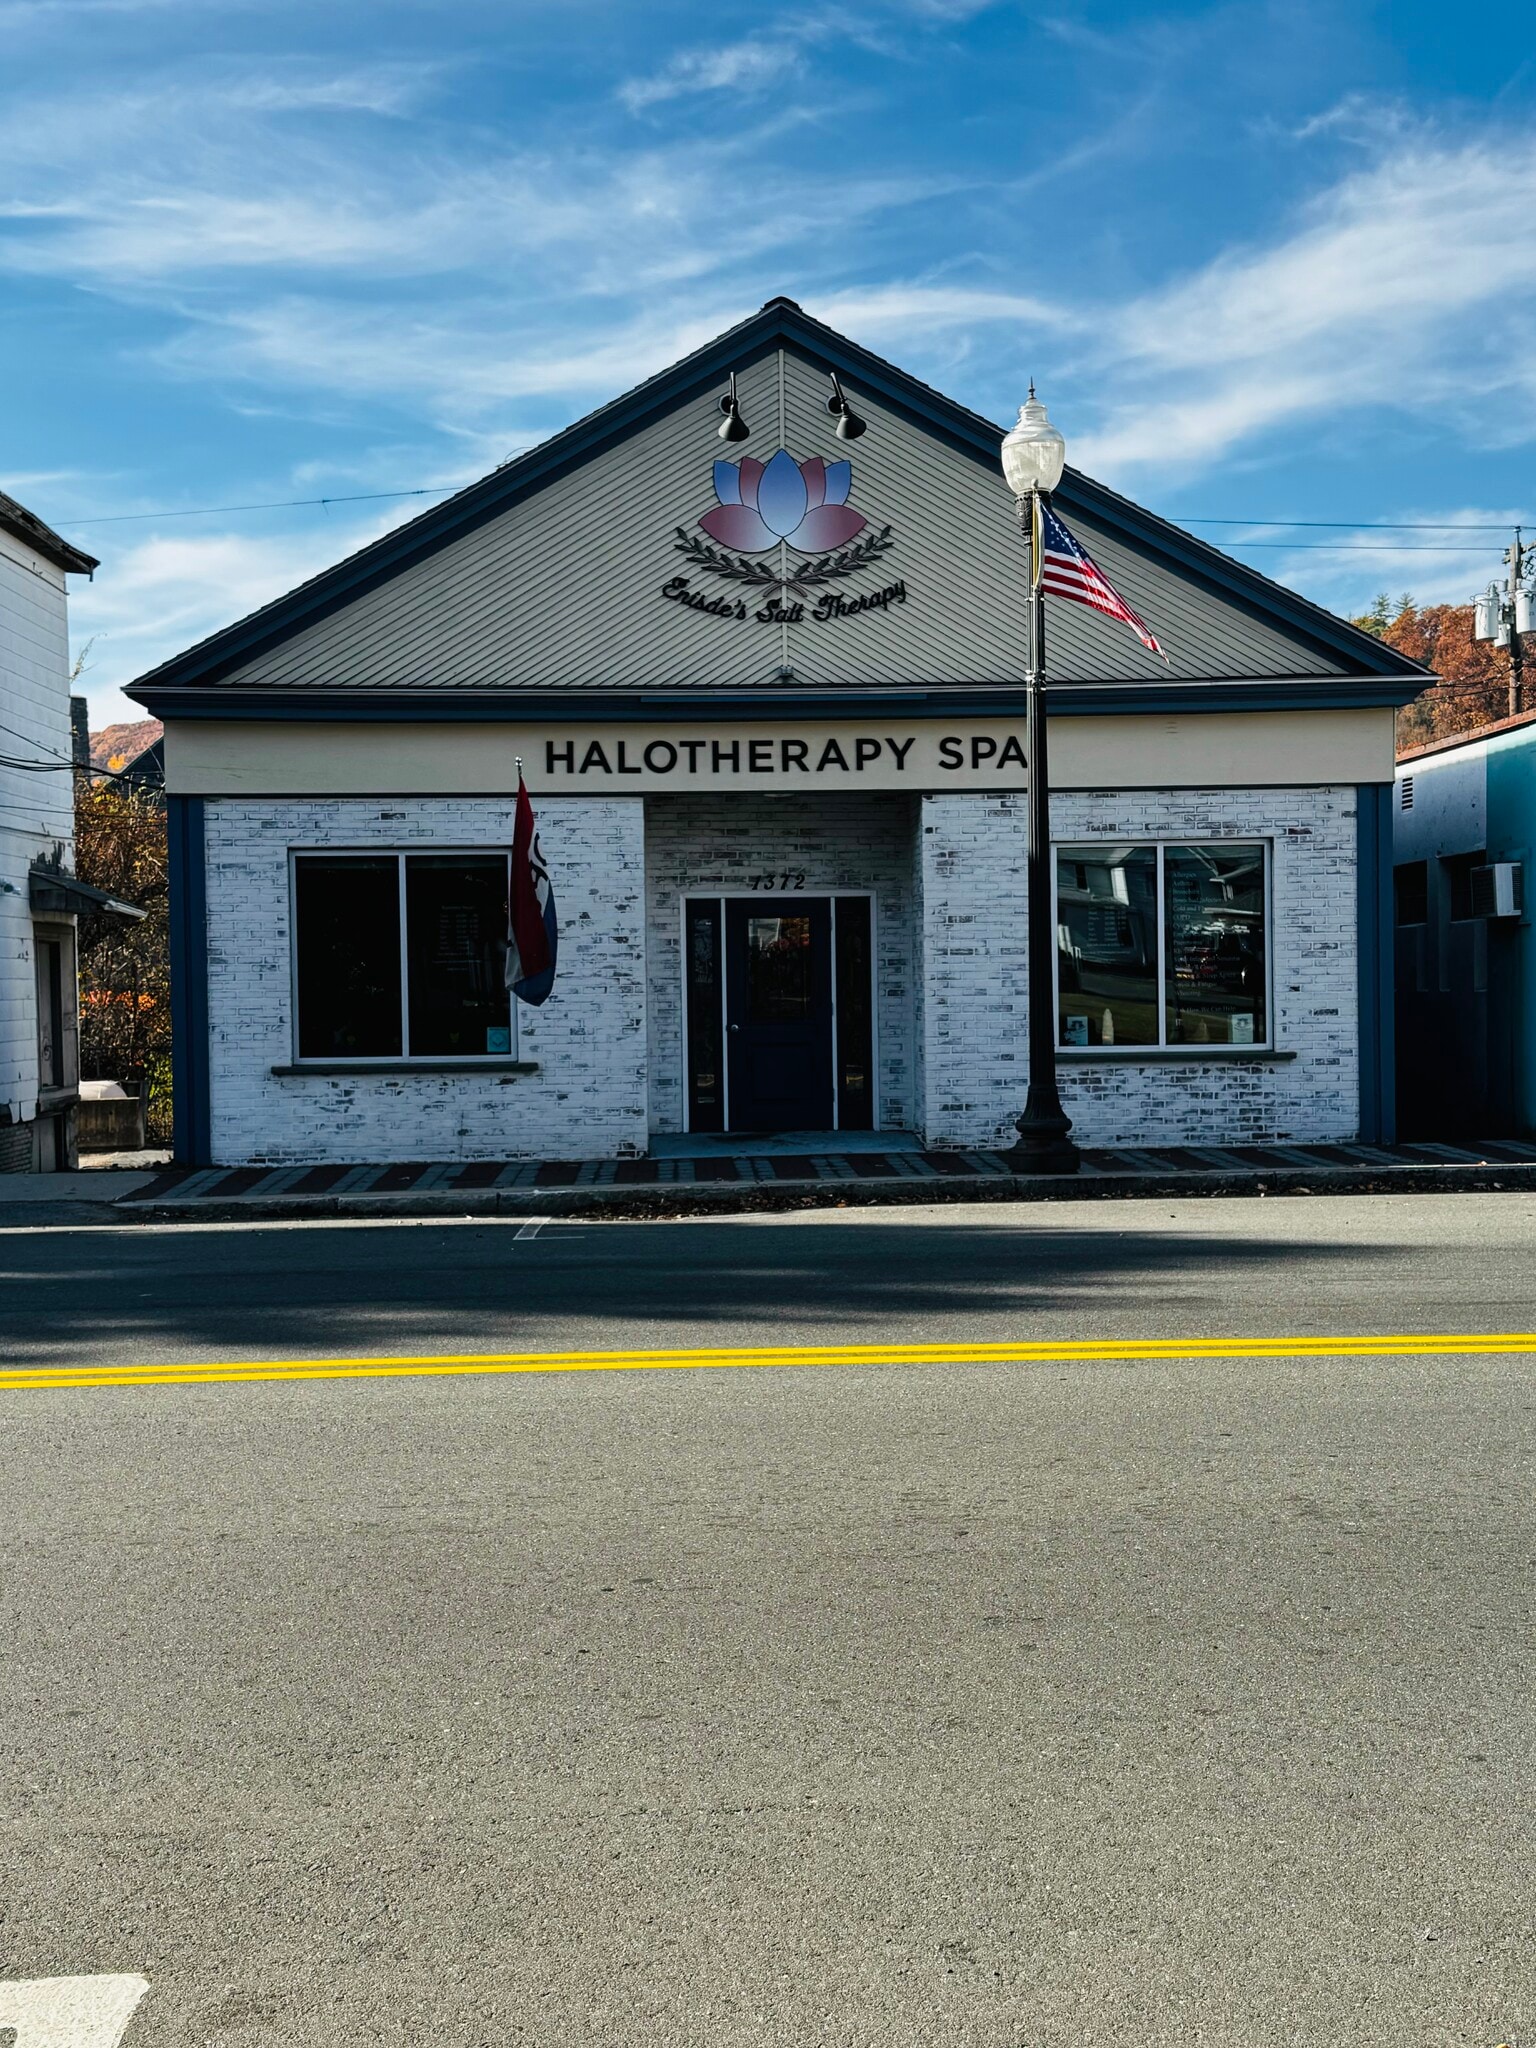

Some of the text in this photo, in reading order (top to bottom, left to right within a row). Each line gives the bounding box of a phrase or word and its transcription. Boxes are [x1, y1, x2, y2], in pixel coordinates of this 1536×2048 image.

[756, 598, 804, 623] Salt
[813, 579, 906, 622] Therapy
[546, 736, 1028, 774] HALOTHERAPY SPA
[751, 874, 806, 891] 1372
